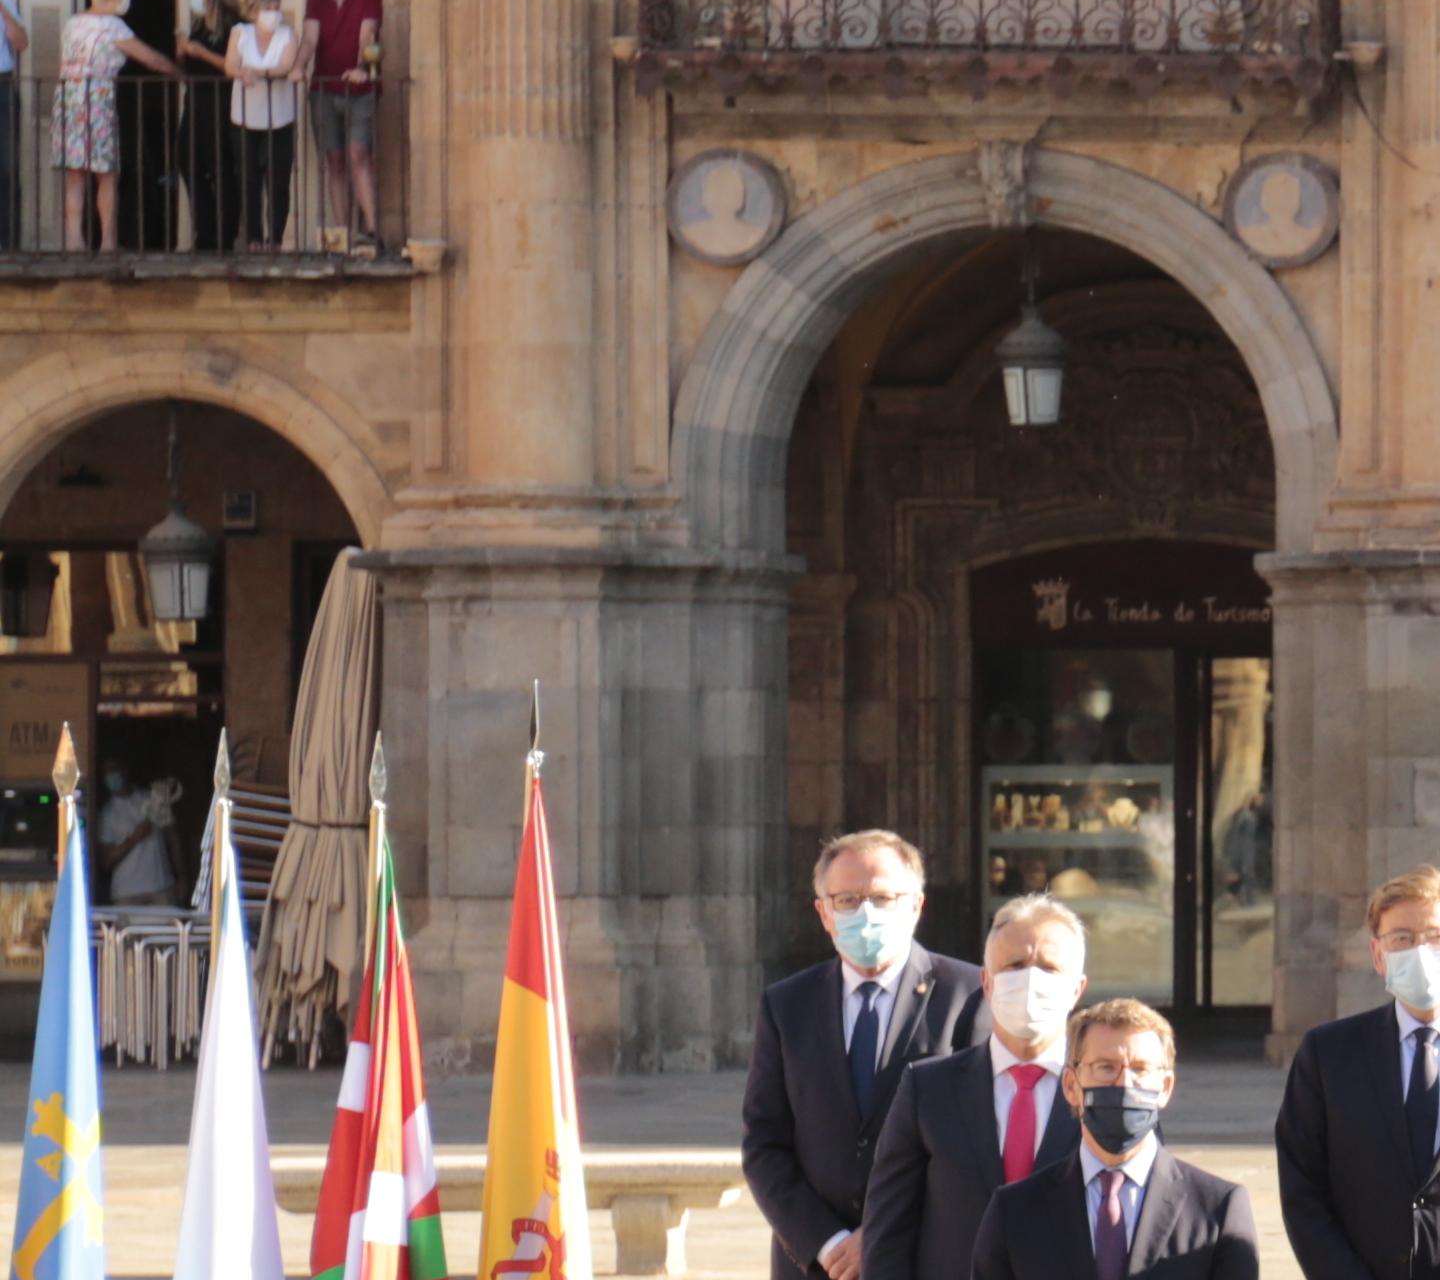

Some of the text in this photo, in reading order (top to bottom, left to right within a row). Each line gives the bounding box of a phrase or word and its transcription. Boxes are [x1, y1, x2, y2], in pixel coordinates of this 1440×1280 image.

[1072, 596, 1272, 622] La Tienda de Turismo
[9, 721, 49, 745] ATM
